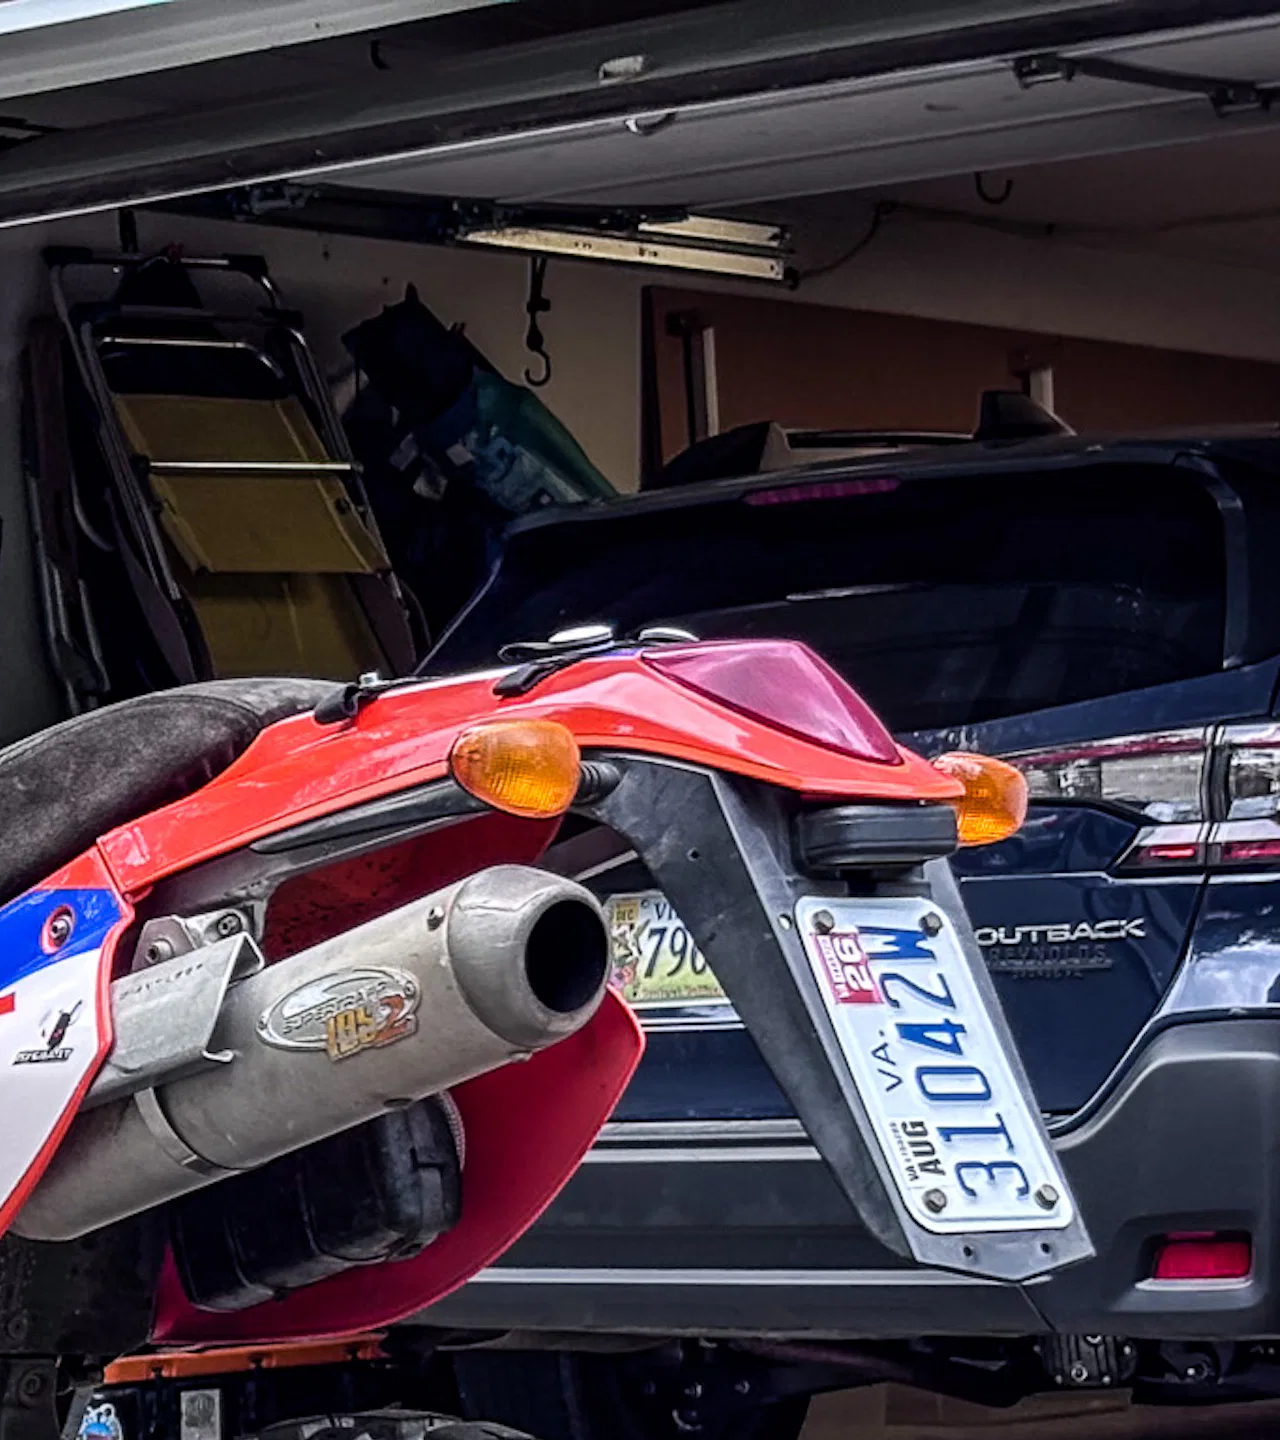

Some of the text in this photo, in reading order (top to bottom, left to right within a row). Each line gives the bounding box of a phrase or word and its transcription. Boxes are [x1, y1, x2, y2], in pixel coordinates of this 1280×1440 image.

[974, 917, 1147, 947] OUTBACK
[856, 925, 1030, 1198] 31042W
[901, 1120, 947, 1176] AUG
